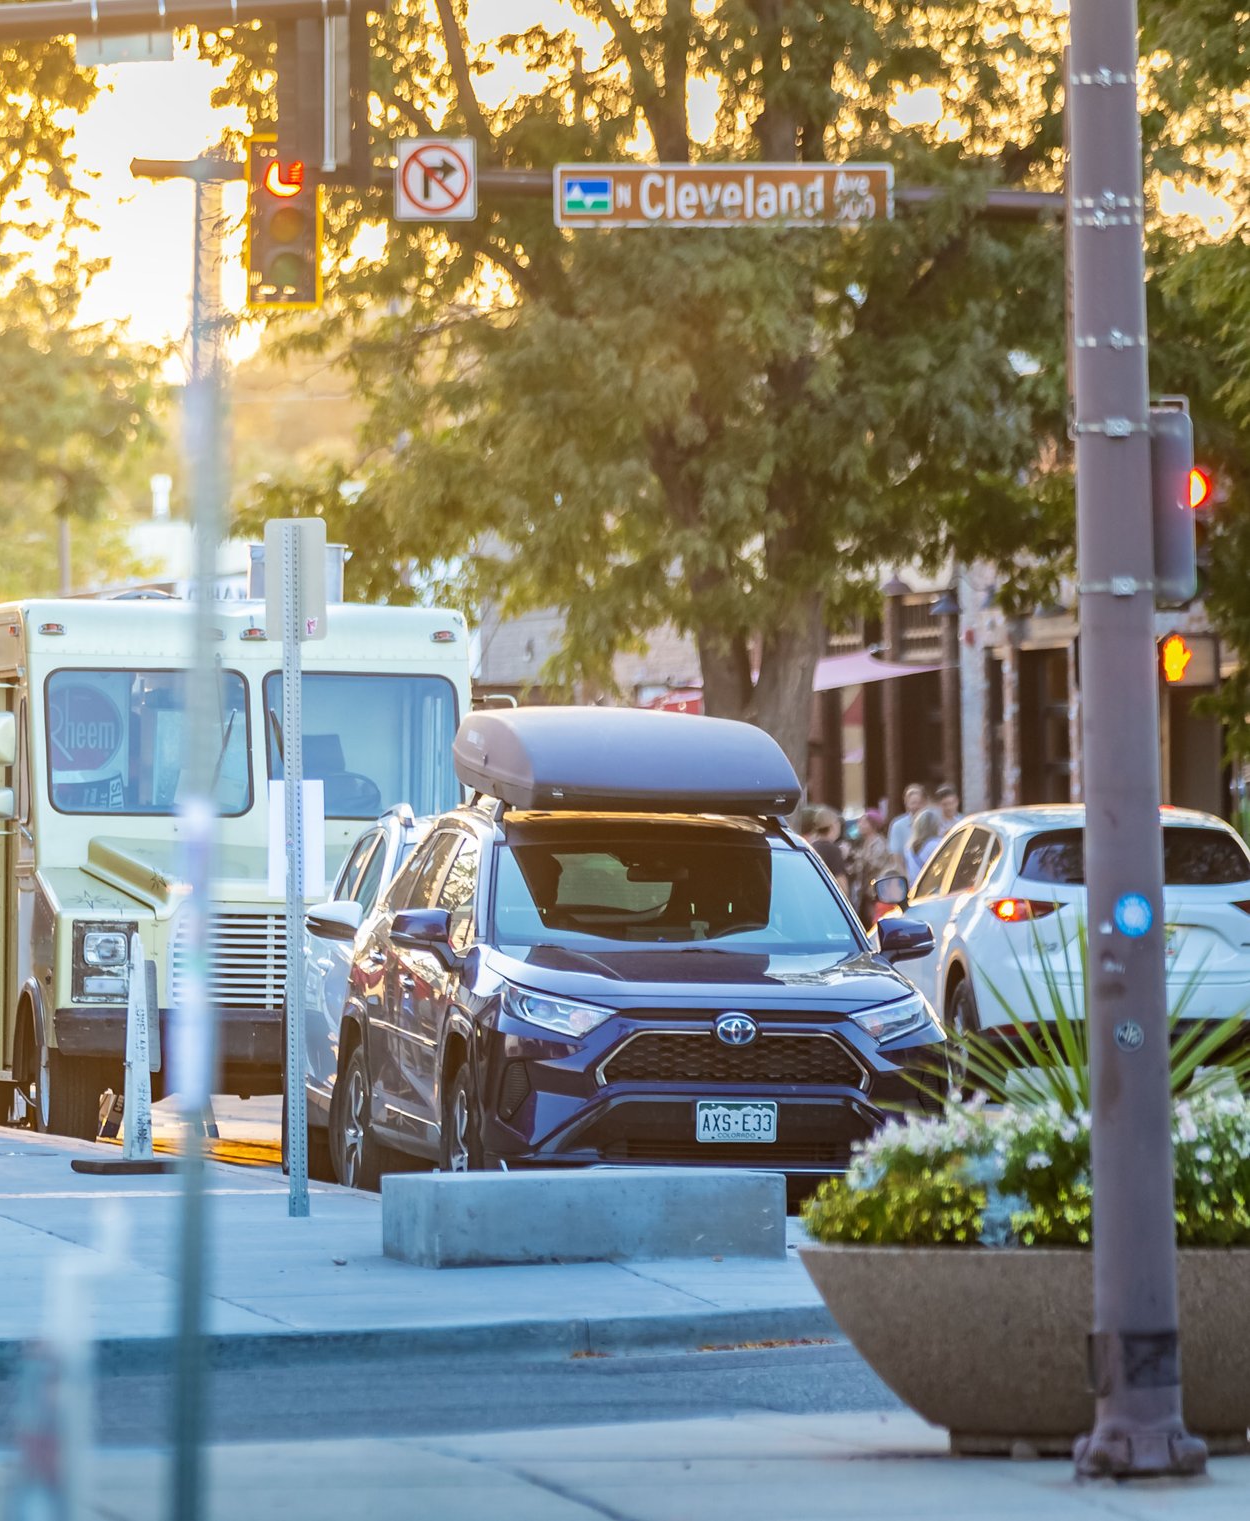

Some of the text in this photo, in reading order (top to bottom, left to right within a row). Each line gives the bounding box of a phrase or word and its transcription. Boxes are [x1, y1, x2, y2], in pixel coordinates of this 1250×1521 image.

[615, 171, 872, 219] N Cleveland Ave
[50, 690, 115, 761] Rheem
